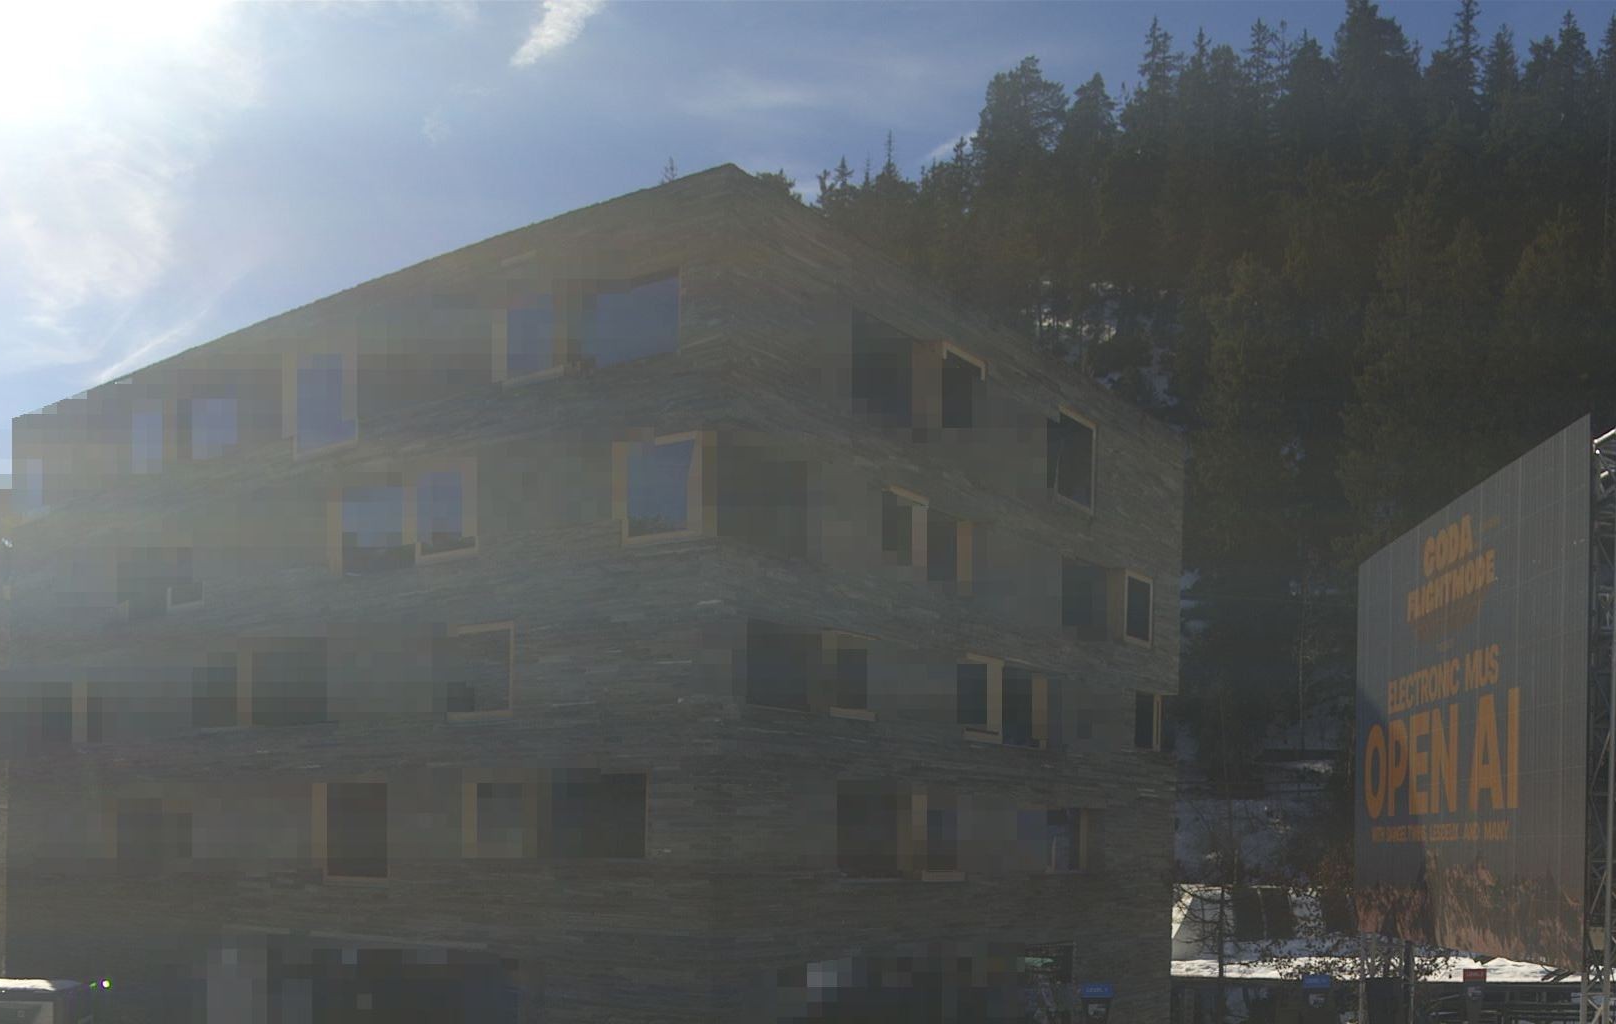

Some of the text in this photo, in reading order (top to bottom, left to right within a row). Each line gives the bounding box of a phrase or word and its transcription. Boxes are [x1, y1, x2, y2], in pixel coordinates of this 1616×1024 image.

[1422, 513, 1473, 578] CODA
[1407, 549, 1497, 623] FLIGHTMODE
[1387, 644, 1500, 714] ELECTRONIC MUS
[1364, 685, 1521, 819] OPEN AI
